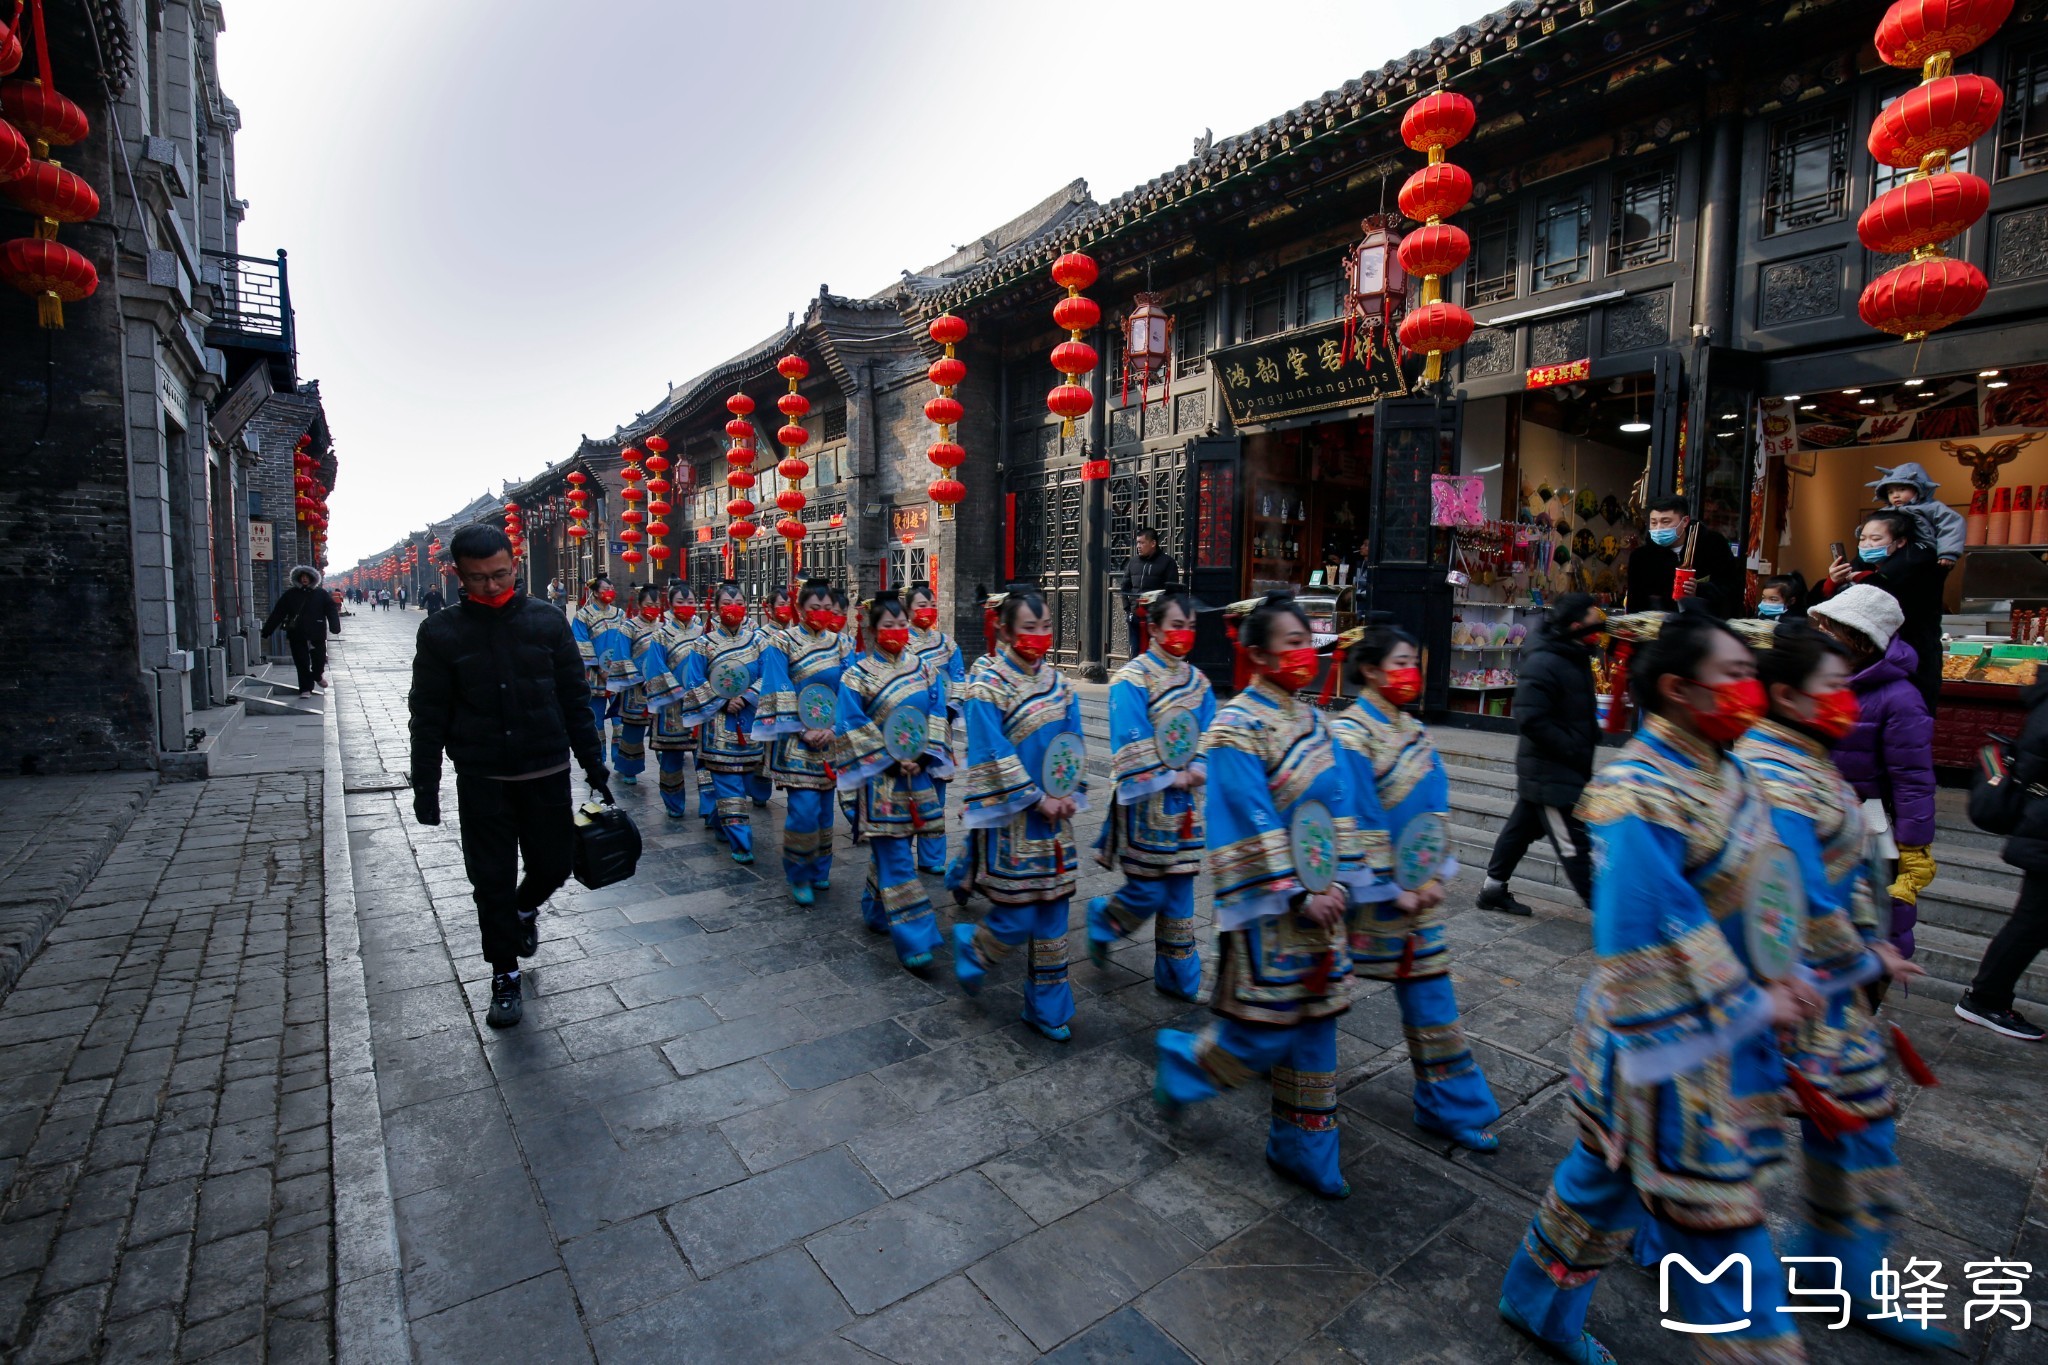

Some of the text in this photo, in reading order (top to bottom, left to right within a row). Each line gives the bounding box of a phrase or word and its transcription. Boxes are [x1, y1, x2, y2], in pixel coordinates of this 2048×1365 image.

[1226, 335, 1385, 389] 鸿韵堂客栈
[1236, 371, 1389, 410] hongyuntanginns
[893, 508, 928, 530] 便利超市
